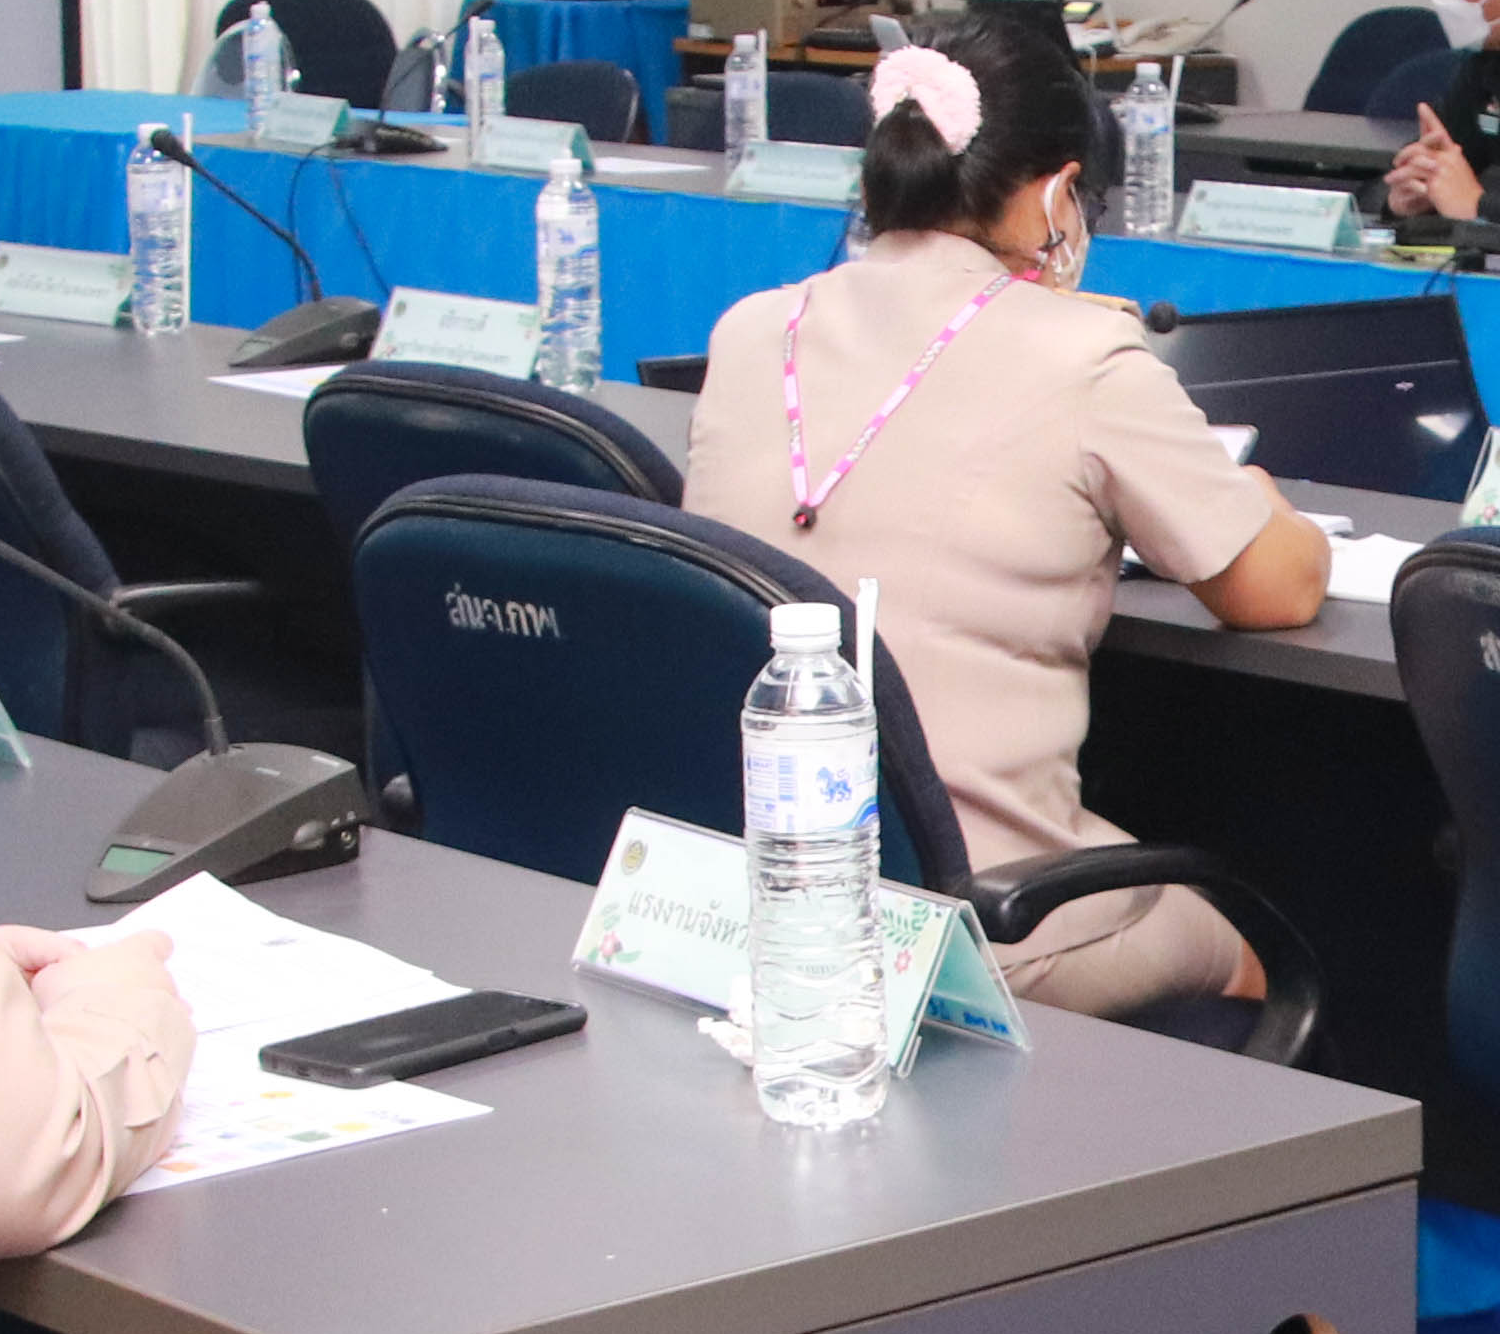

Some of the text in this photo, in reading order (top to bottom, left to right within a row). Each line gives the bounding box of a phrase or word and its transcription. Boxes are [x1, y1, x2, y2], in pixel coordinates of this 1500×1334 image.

[627, 890, 749, 951] แรงงานจังหว
